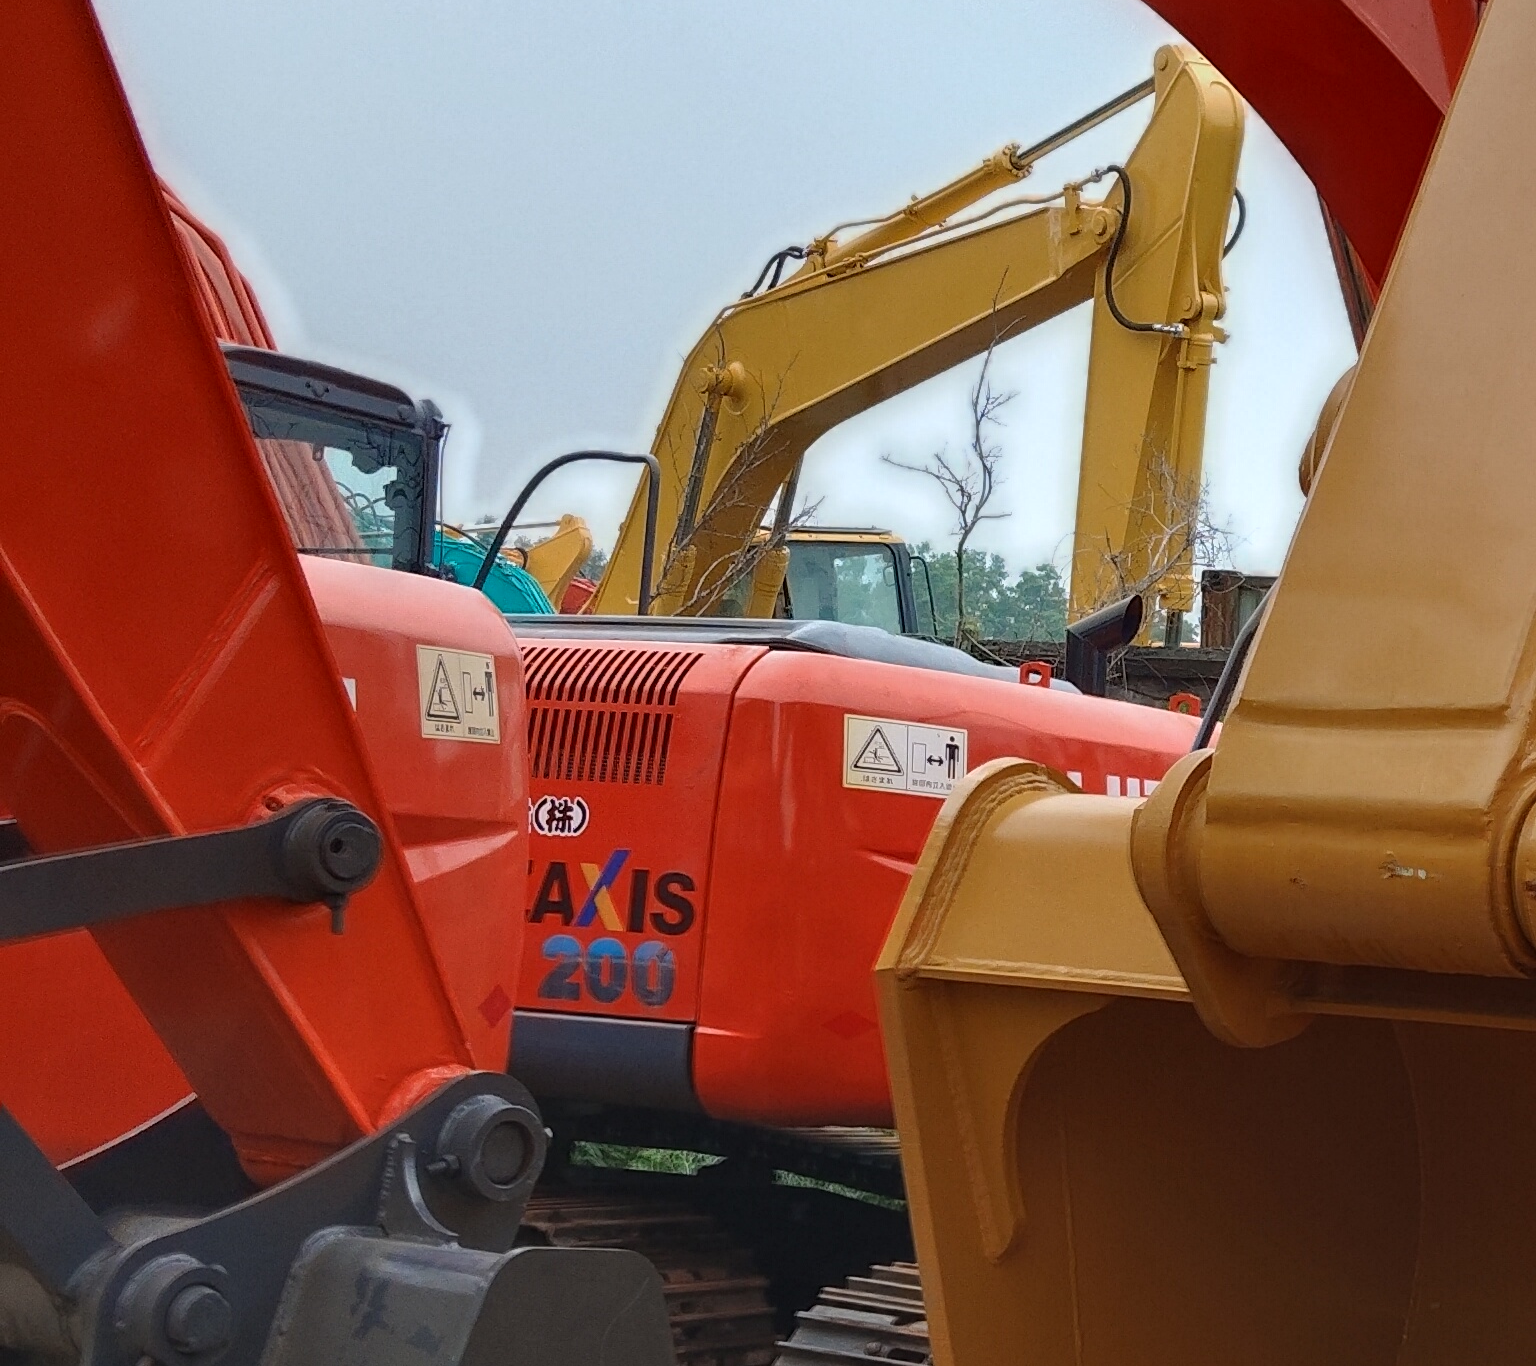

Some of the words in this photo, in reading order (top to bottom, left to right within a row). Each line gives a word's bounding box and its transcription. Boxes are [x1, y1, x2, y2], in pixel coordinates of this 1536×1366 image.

[528, 796, 589, 835] (株)
[526, 849, 696, 936] AXIS
[537, 934, 677, 1009] 200
